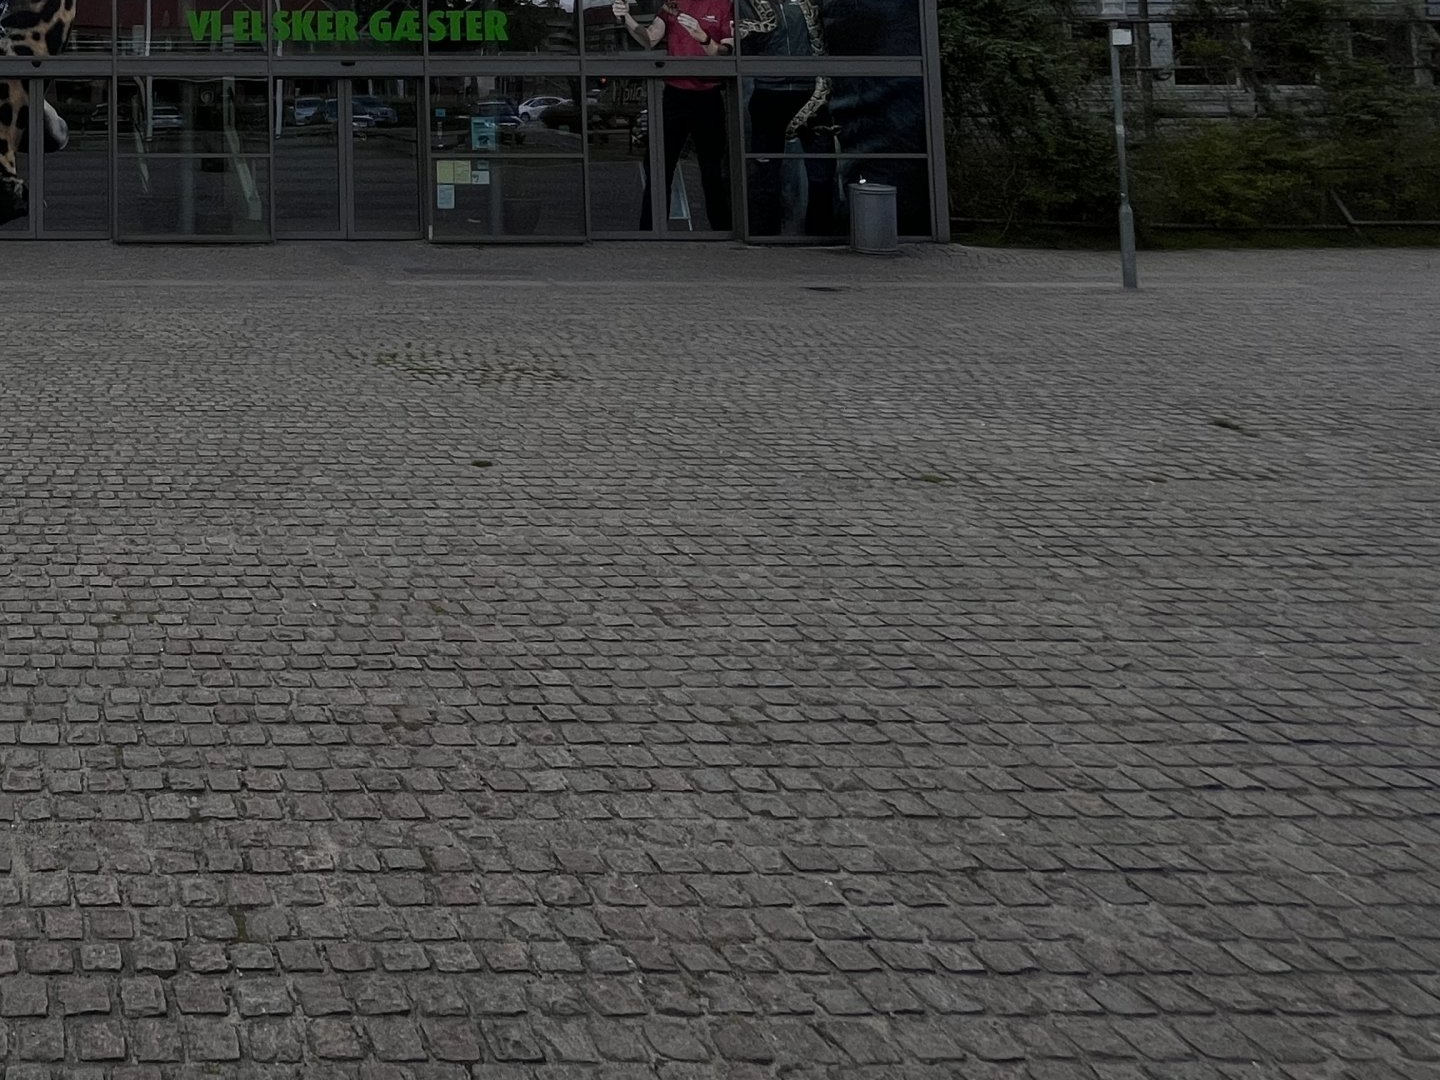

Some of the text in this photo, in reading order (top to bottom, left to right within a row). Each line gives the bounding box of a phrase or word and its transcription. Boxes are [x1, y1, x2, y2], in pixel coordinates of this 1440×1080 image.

[188, 9, 508, 42] VI ELSKER GÆSTER
